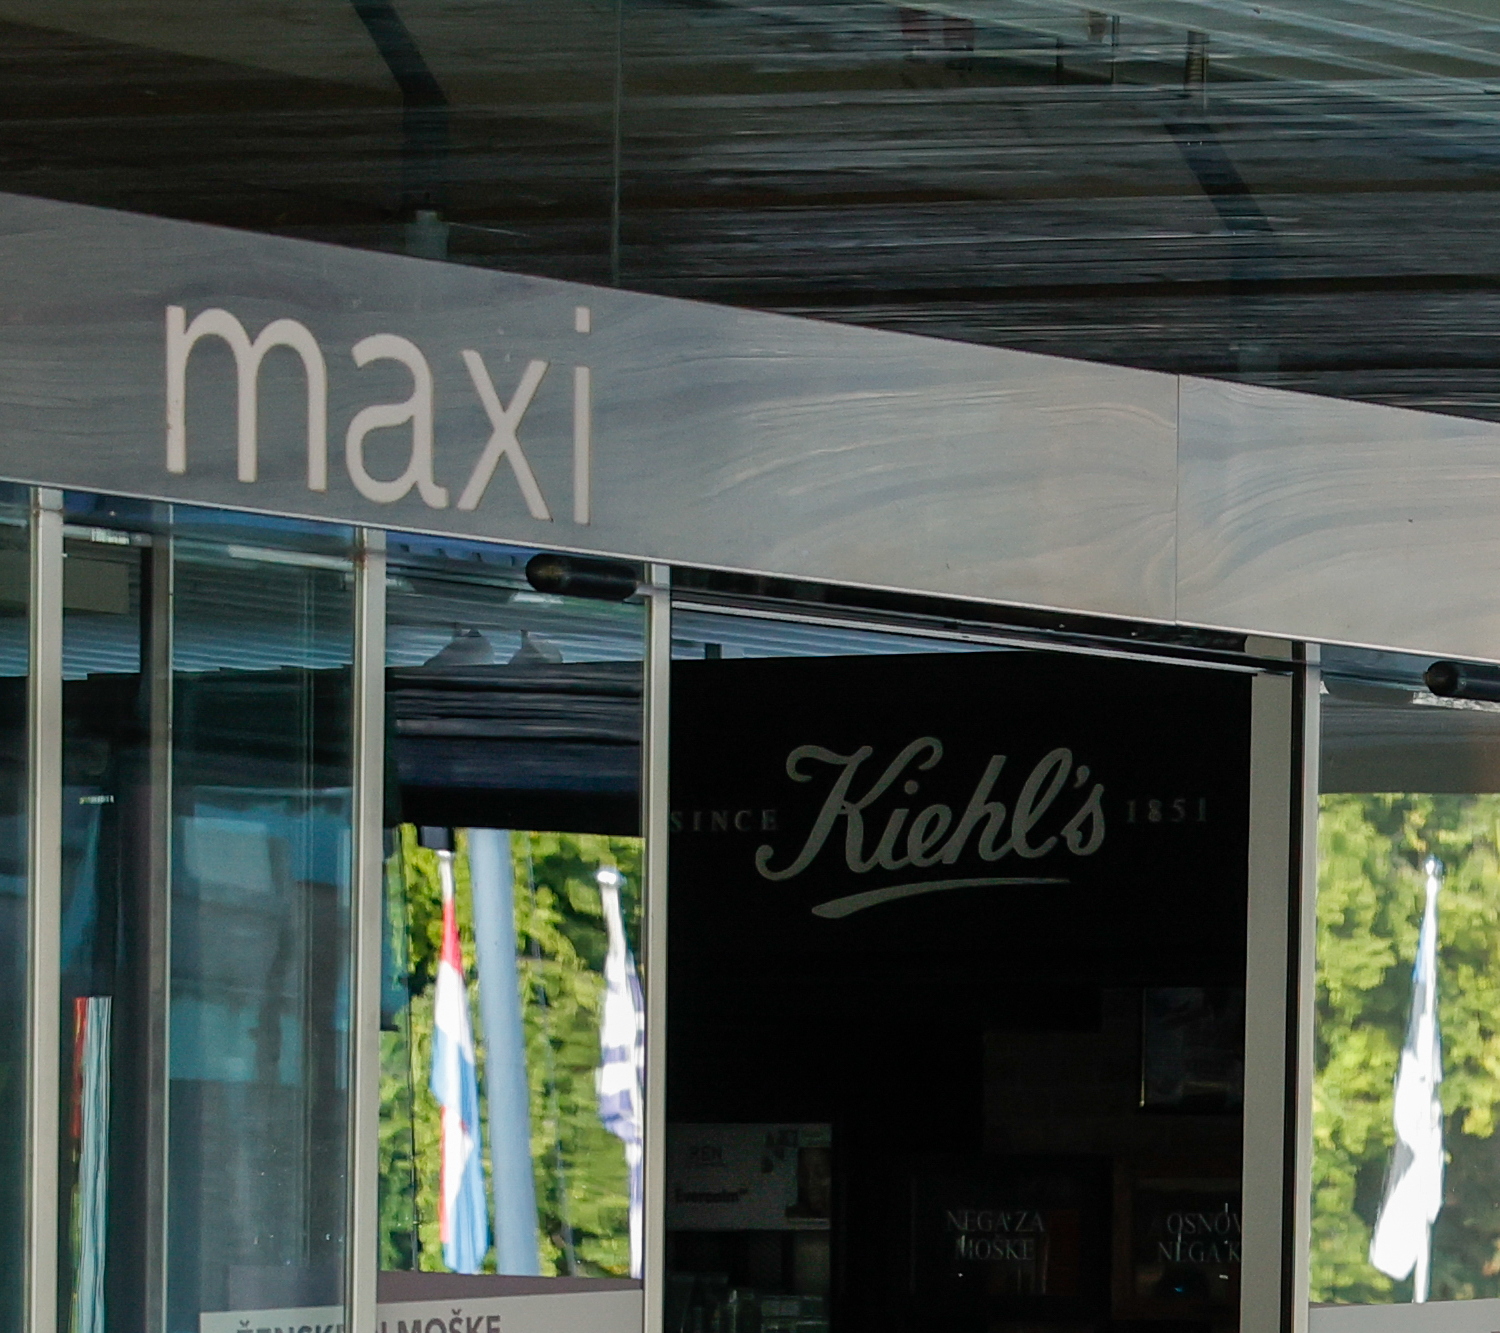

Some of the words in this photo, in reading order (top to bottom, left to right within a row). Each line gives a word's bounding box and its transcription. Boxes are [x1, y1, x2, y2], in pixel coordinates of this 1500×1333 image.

[165, 304, 591, 526] maxi
[754, 734, 1107, 883] Kiehl's
[1125, 797, 1209, 824] 1851
